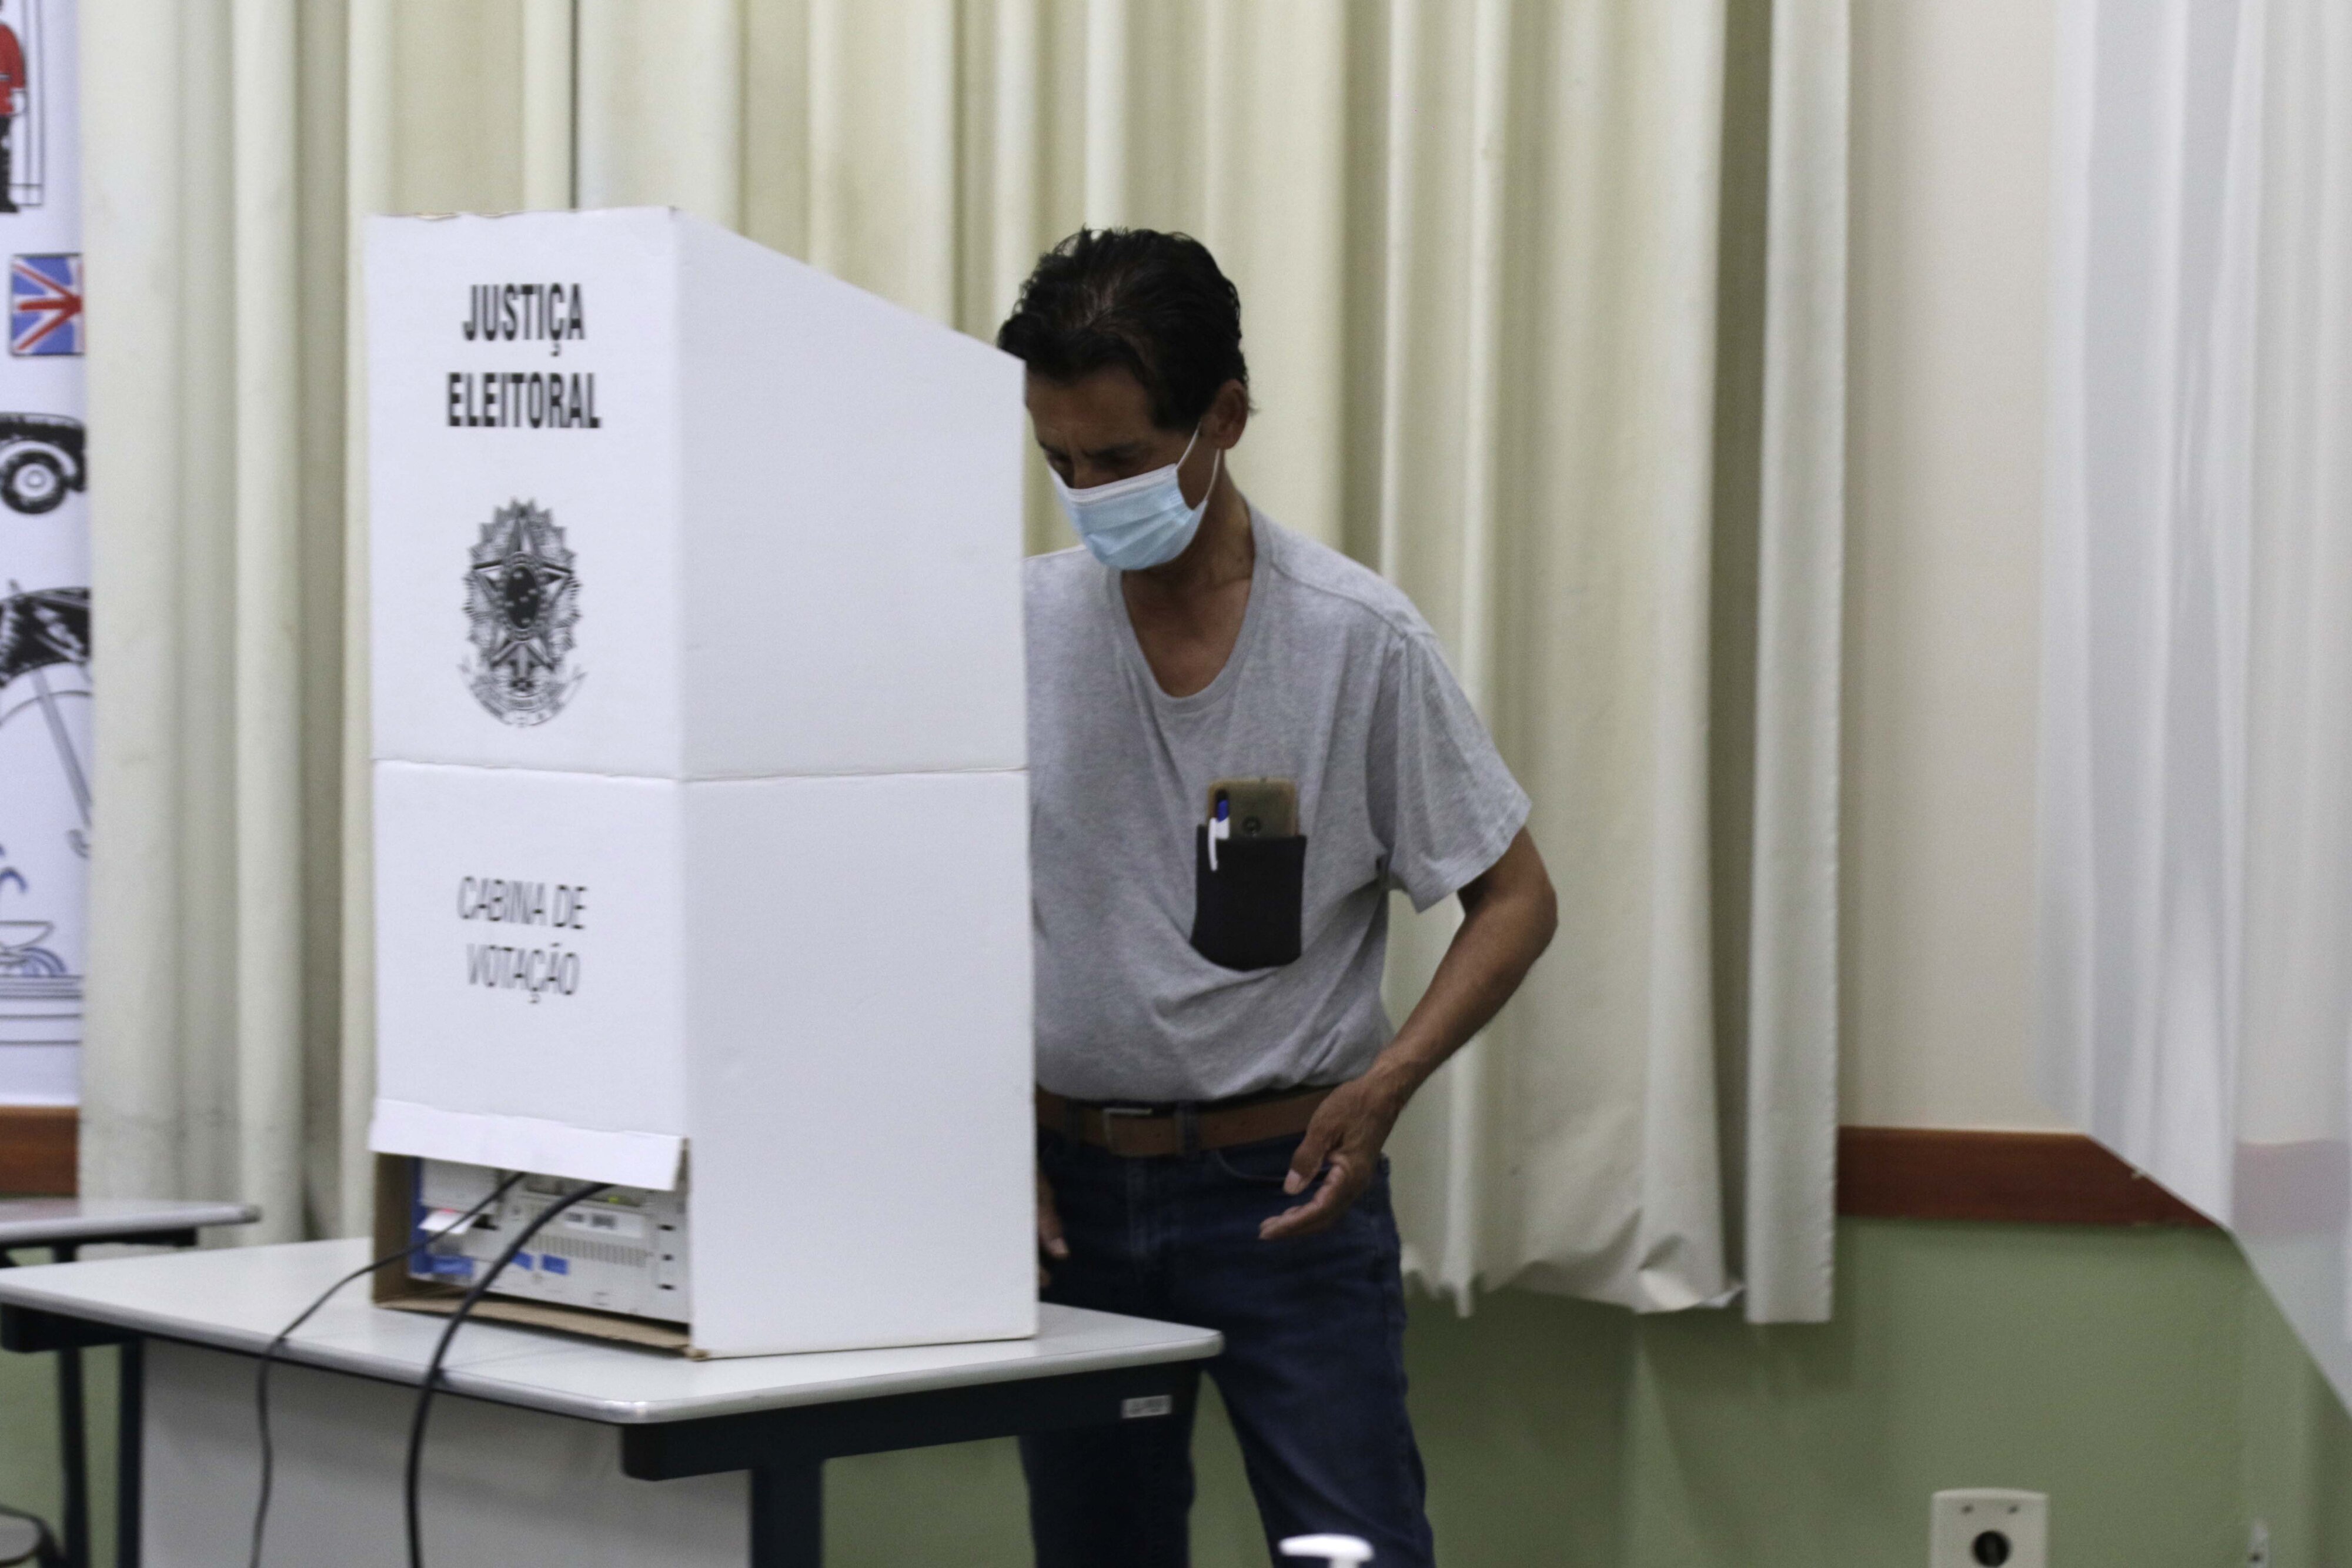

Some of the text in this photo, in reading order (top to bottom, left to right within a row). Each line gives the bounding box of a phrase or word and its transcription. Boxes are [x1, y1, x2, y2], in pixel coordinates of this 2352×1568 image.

[462, 283, 586, 356] JUSTIÇA
[447, 372, 602, 429] ELEITORAL
[457, 876, 588, 930] CABINA DE
[466, 941, 580, 1004] VOTAÇÃO
